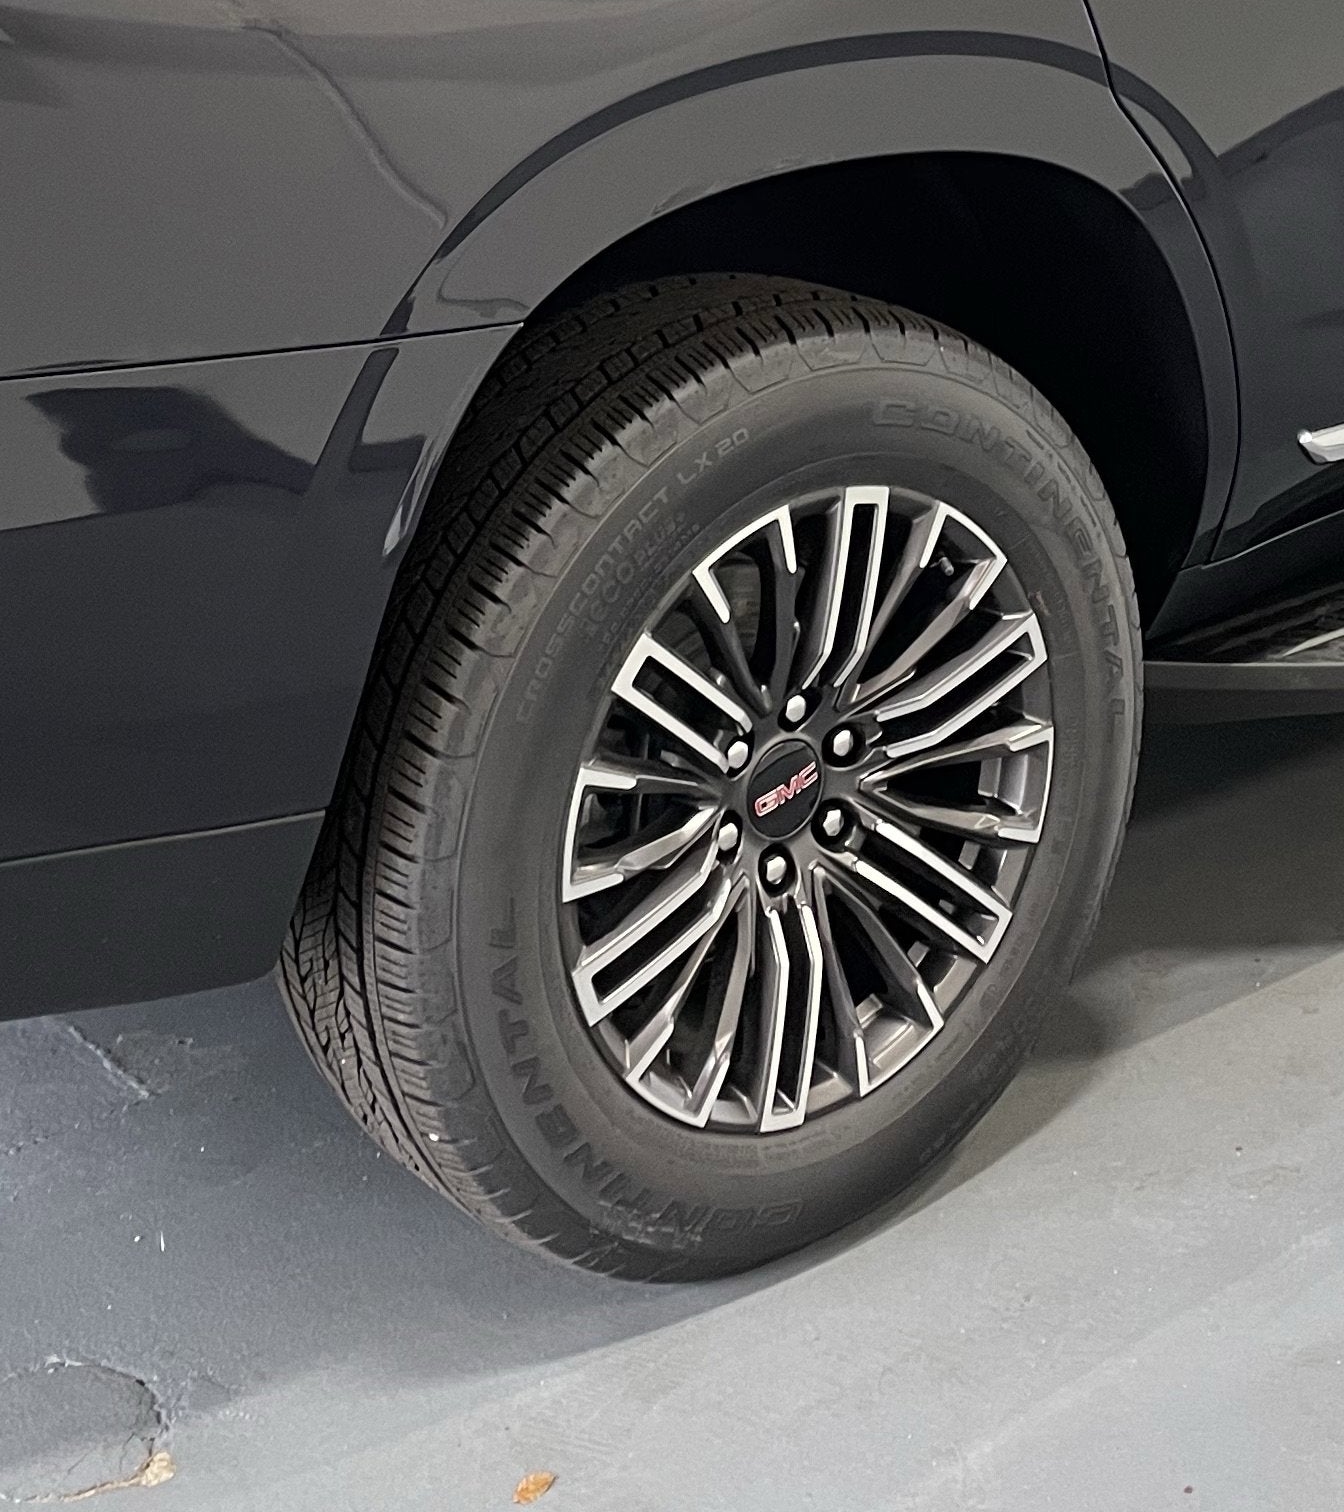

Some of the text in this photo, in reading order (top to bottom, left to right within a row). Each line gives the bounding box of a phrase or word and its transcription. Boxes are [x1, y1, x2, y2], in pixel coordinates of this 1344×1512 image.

[516, 426, 750, 722] CROSSCONTACT LX 20
[872, 402, 1126, 718] CONTINENTAL
[754, 760, 819, 818] GMC
[490, 896, 806, 1250] CONTINENTAL
